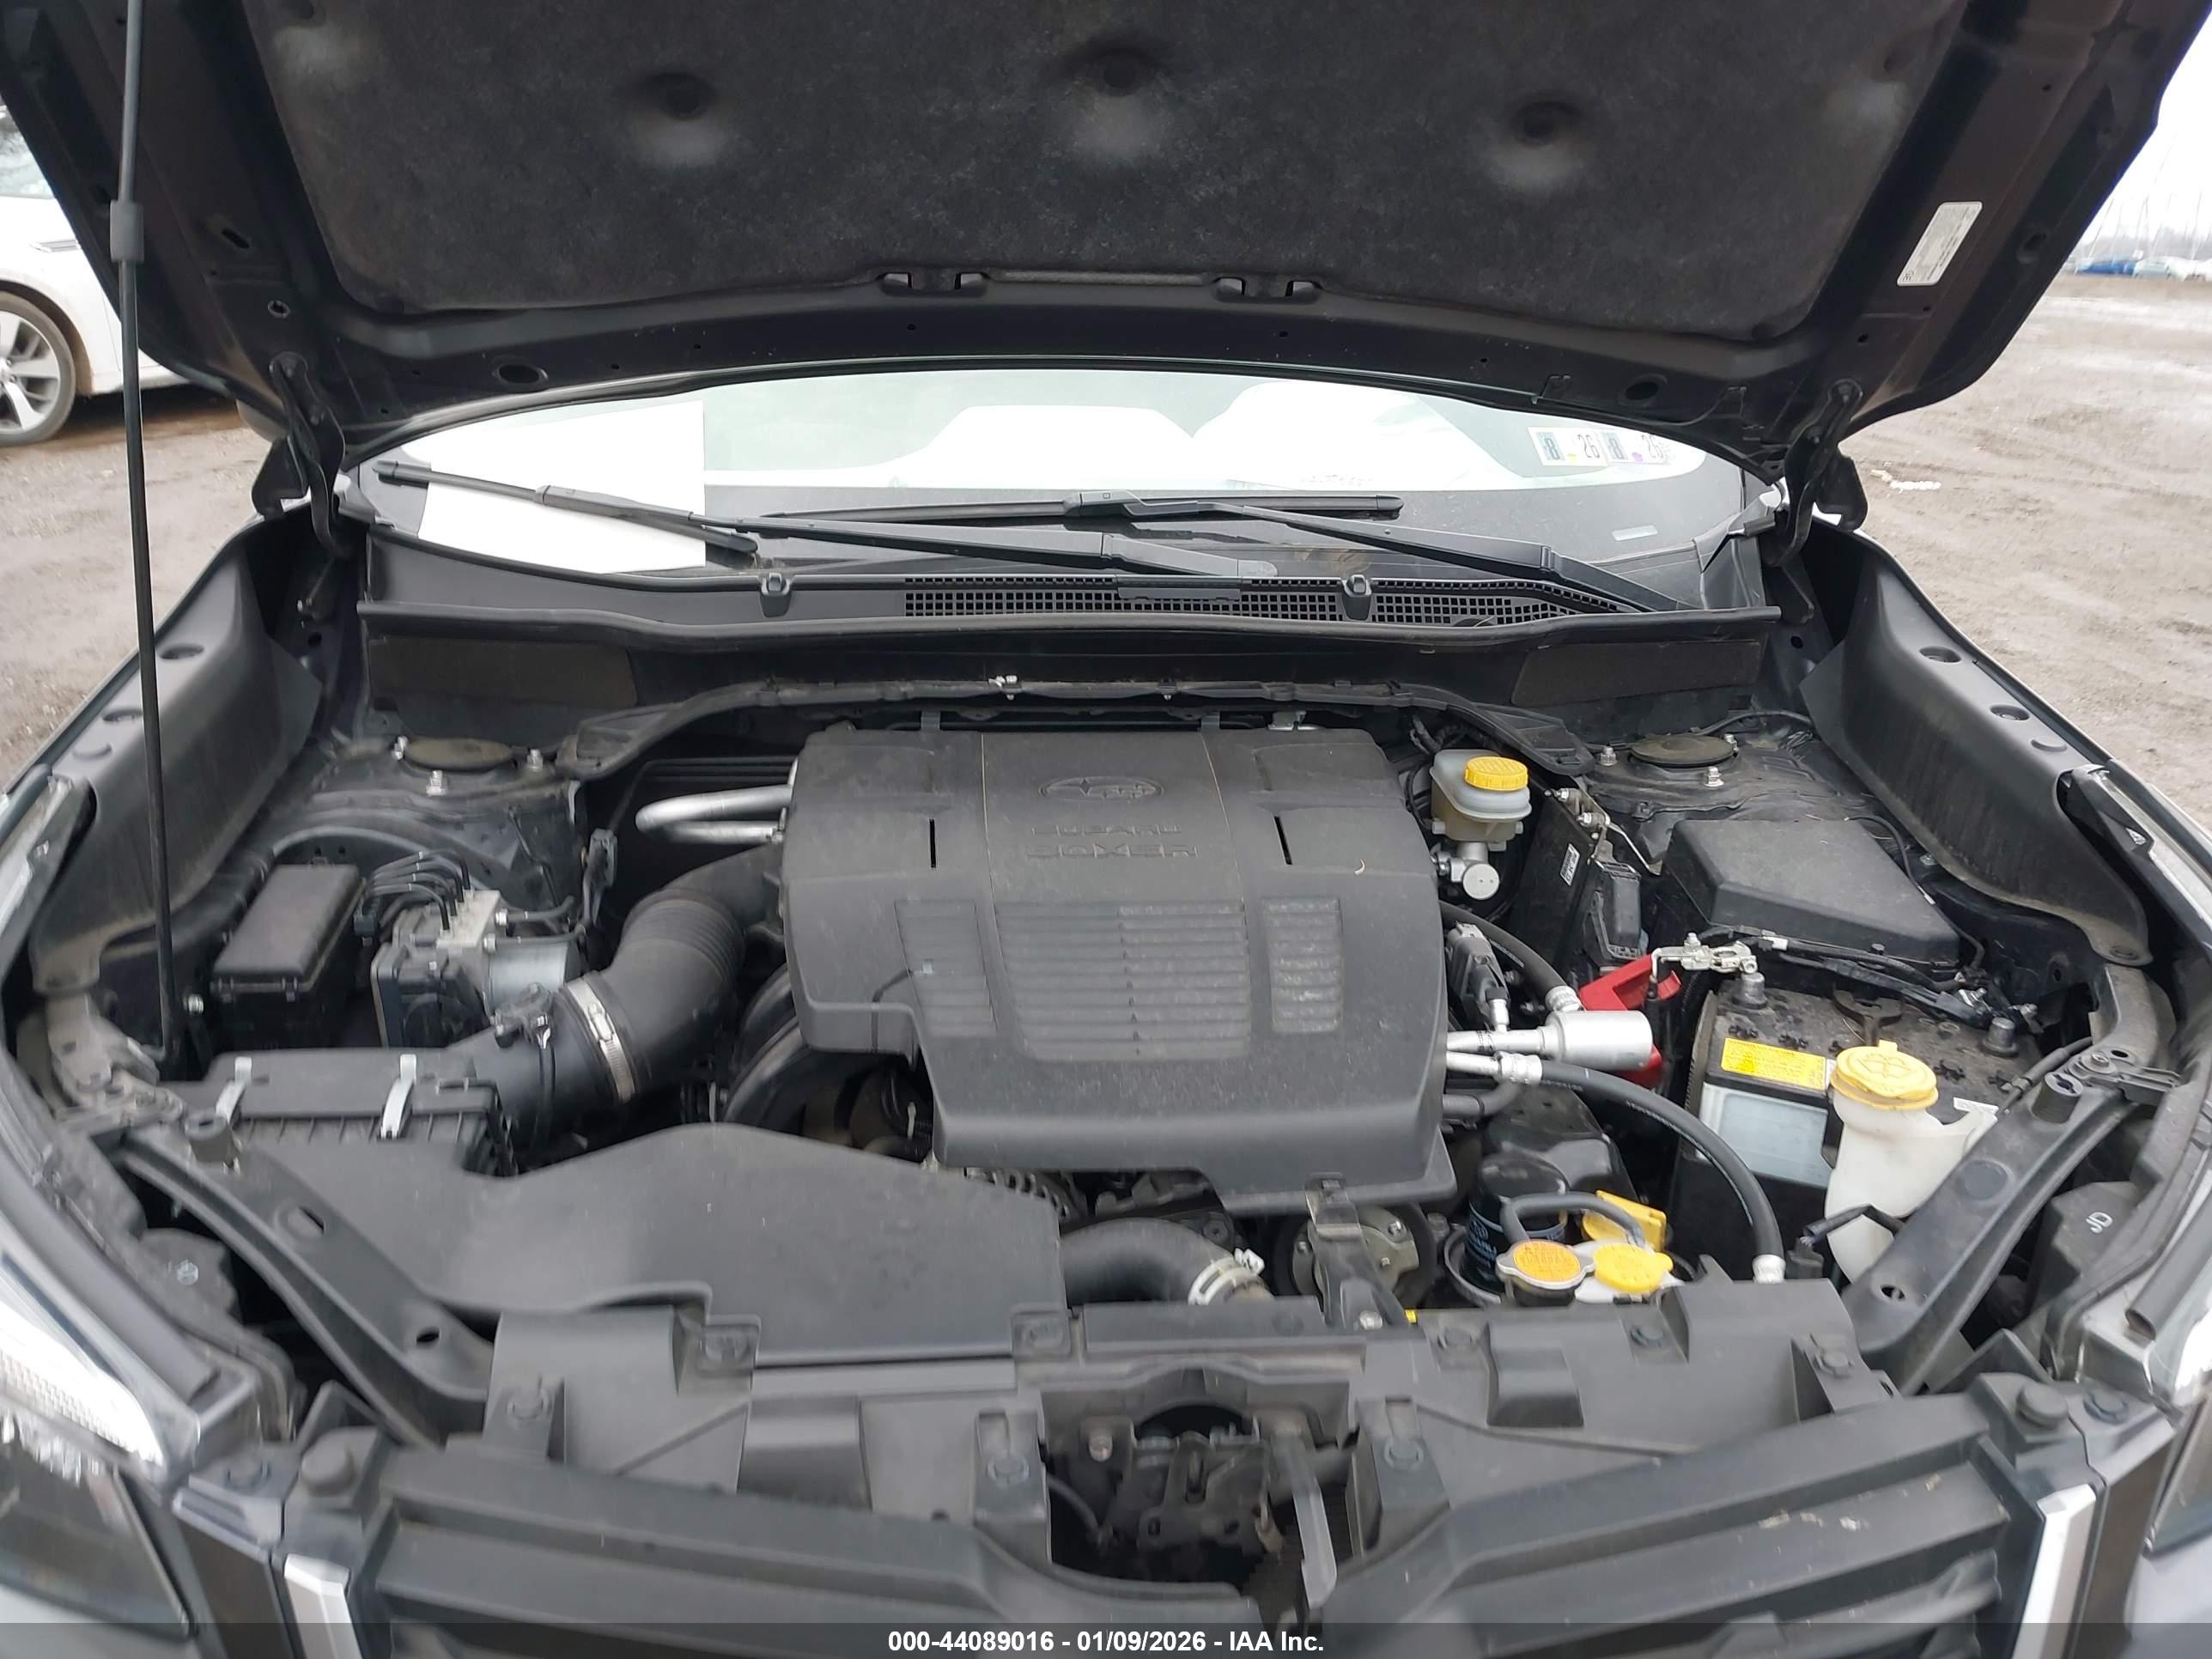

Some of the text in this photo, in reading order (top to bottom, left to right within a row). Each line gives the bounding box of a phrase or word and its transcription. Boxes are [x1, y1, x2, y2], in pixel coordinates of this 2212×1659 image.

[1577, 434, 1601, 459] 26
[1030, 823, 1182, 836] SUBARU
[1024, 842, 1200, 859] BOXER
